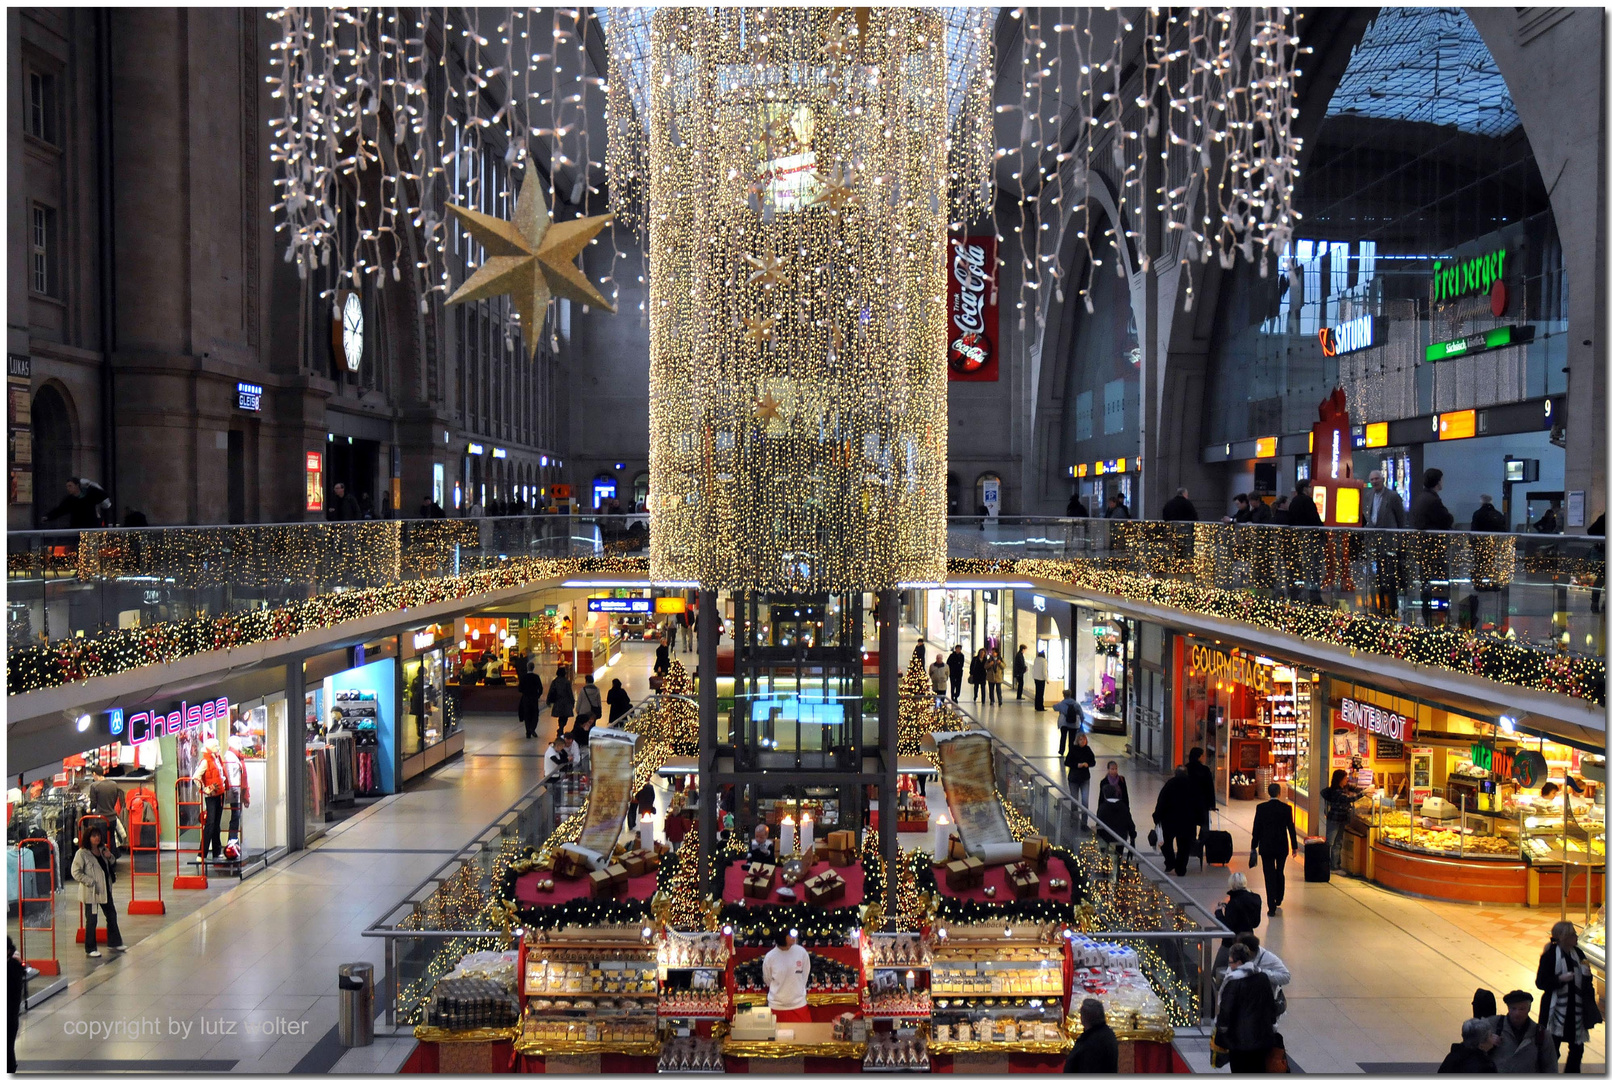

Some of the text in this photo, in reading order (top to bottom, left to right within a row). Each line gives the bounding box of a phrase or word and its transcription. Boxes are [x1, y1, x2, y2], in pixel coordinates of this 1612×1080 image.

[1335, 314, 1372, 355] SATURN
[9, 356, 29, 376] LUKAS
[1432, 415, 1438, 432] 8
[1544, 399, 1552, 417] 9
[1192, 644, 1271, 695] GOURMÉTAGE
[129, 697, 229, 745] Chelsea
[1341, 698, 1407, 742] ERNTEBROT
